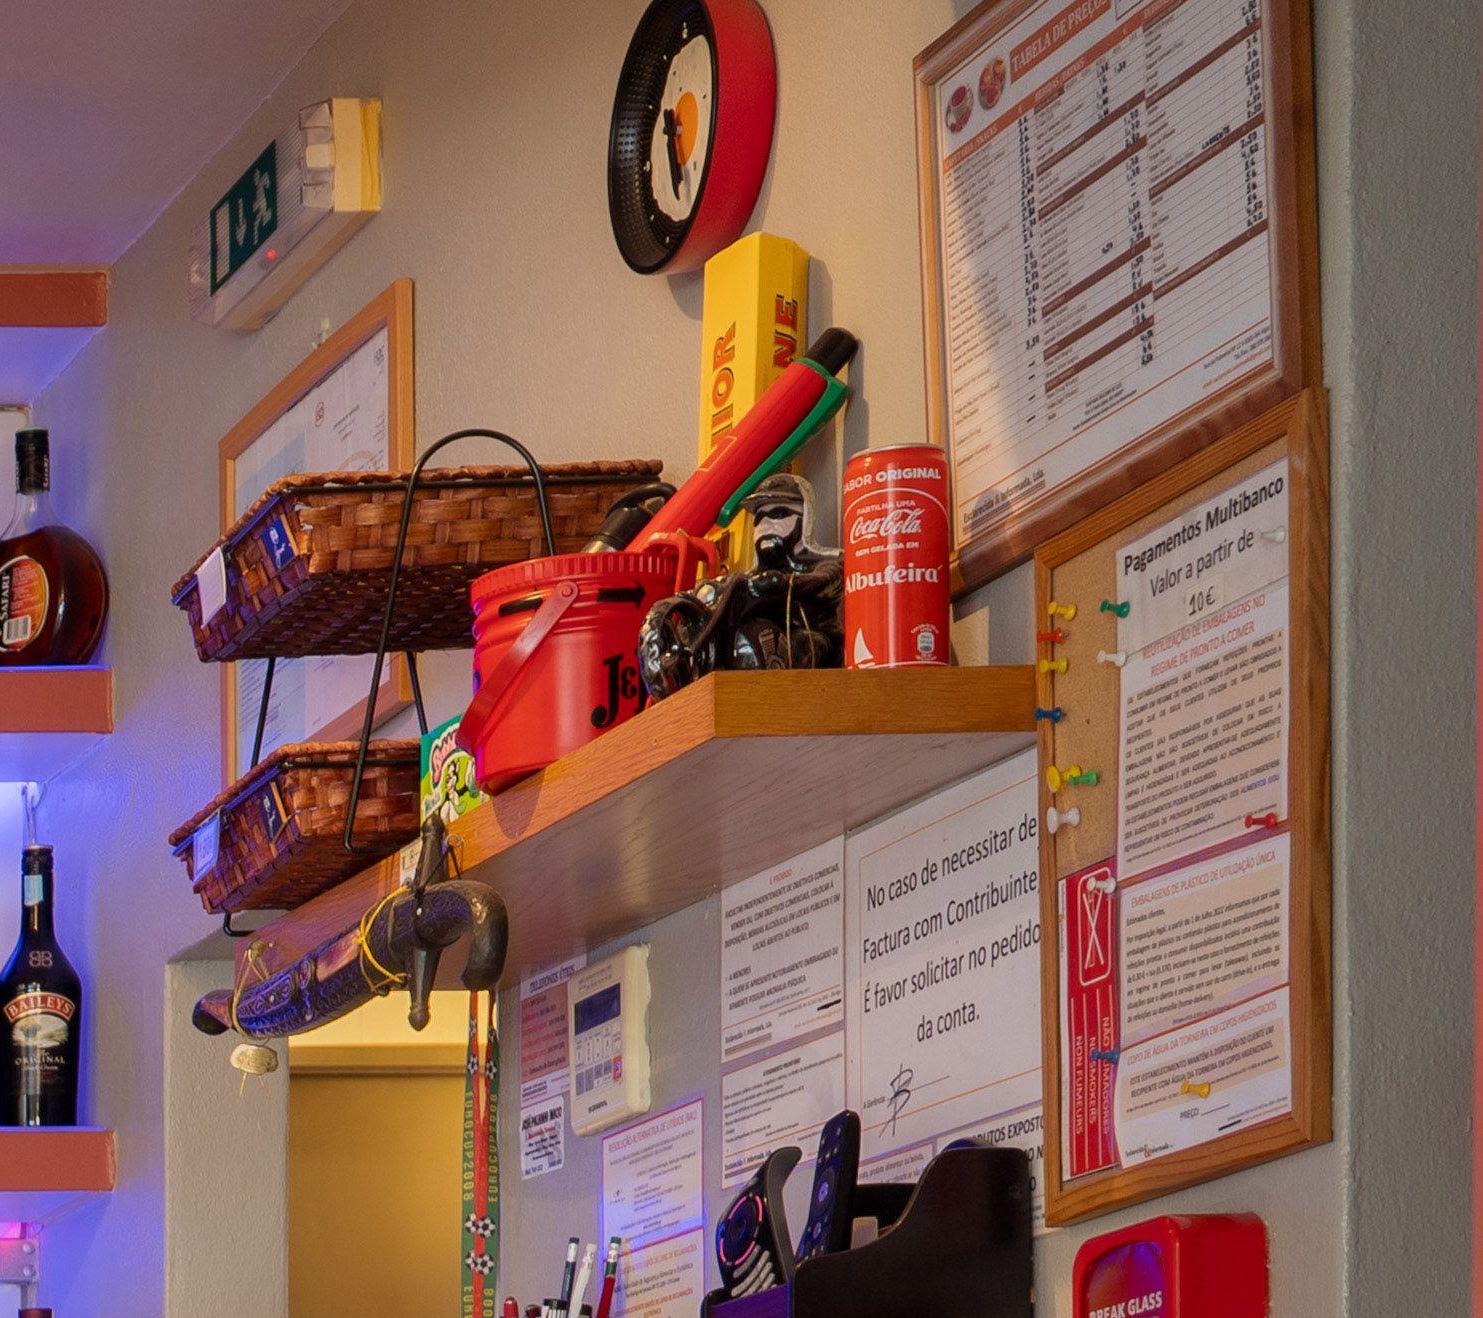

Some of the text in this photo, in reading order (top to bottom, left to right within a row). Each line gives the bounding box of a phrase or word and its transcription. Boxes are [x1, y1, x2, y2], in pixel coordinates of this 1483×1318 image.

[1011, 23, 1066, 73] TABELA DE
[875, 467, 941, 483] ORIGINAL
[849, 508, 925, 544] Coca-Cola
[1124, 476, 1284, 576] Pagamentos Multibanco
[1150, 528, 1254, 597] Valor a partir de
[0, 574, 10, 620] SAFARI
[1188, 586, 1215, 617] 10€
[867, 813, 1037, 912] No caso de necessitar de
[863, 925, 910, 964] Factura
[914, 911, 943, 940] com
[863, 919, 1041, 1014] É favor solicitar no pedido
[8, 997, 72, 1016] BAILEYS
[916, 1002, 980, 1042] da conta.
[1127, 1291, 1163, 1316] GLASS
